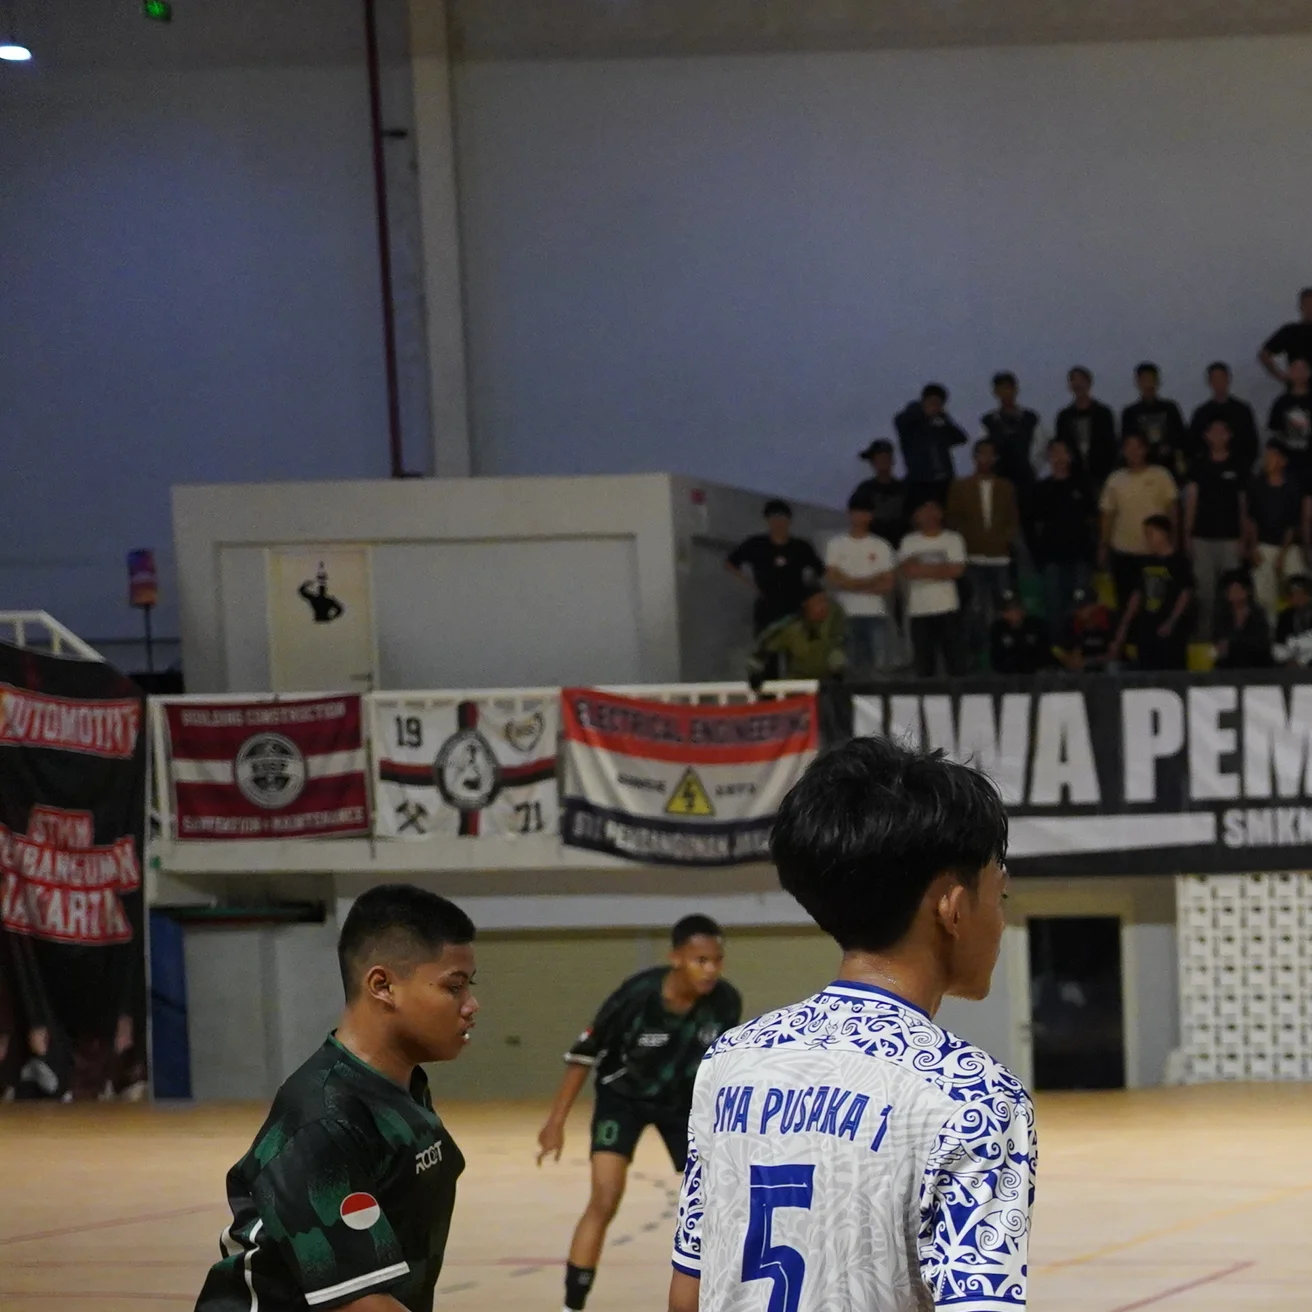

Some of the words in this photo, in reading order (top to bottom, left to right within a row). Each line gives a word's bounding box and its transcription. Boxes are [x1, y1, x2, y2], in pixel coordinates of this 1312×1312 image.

[395, 716, 423, 748] 19
[513, 801, 545, 833] 71
[713, 1085, 754, 1134] SMA
[760, 1085, 871, 1143] PUSAKA
[870, 1103, 895, 1152] 1
